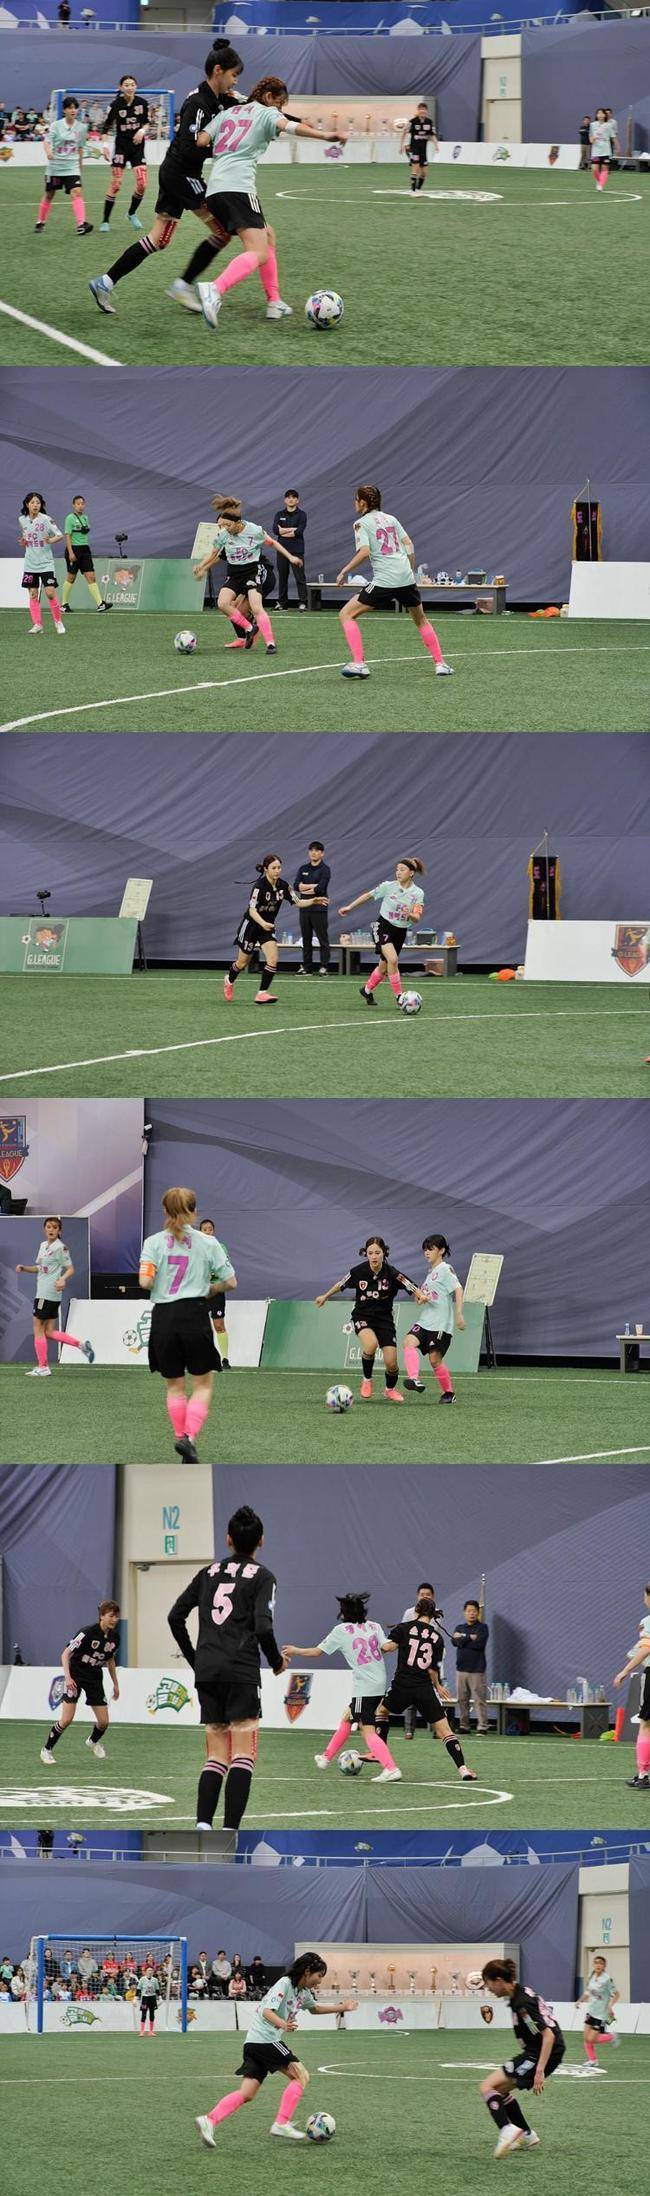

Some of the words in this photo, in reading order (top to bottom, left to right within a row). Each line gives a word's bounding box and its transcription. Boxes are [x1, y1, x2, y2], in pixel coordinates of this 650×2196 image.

[213, 119, 254, 155] 27
[375, 526, 400, 555] 27
[26, 954, 61, 966] G.LEAGUE
[167, 1255, 190, 1295] 7
[162, 1505, 181, 1530] N2
[210, 1582, 236, 1626] 5
[352, 1634, 382, 1666] 28
[406, 1638, 434, 1670] 13
